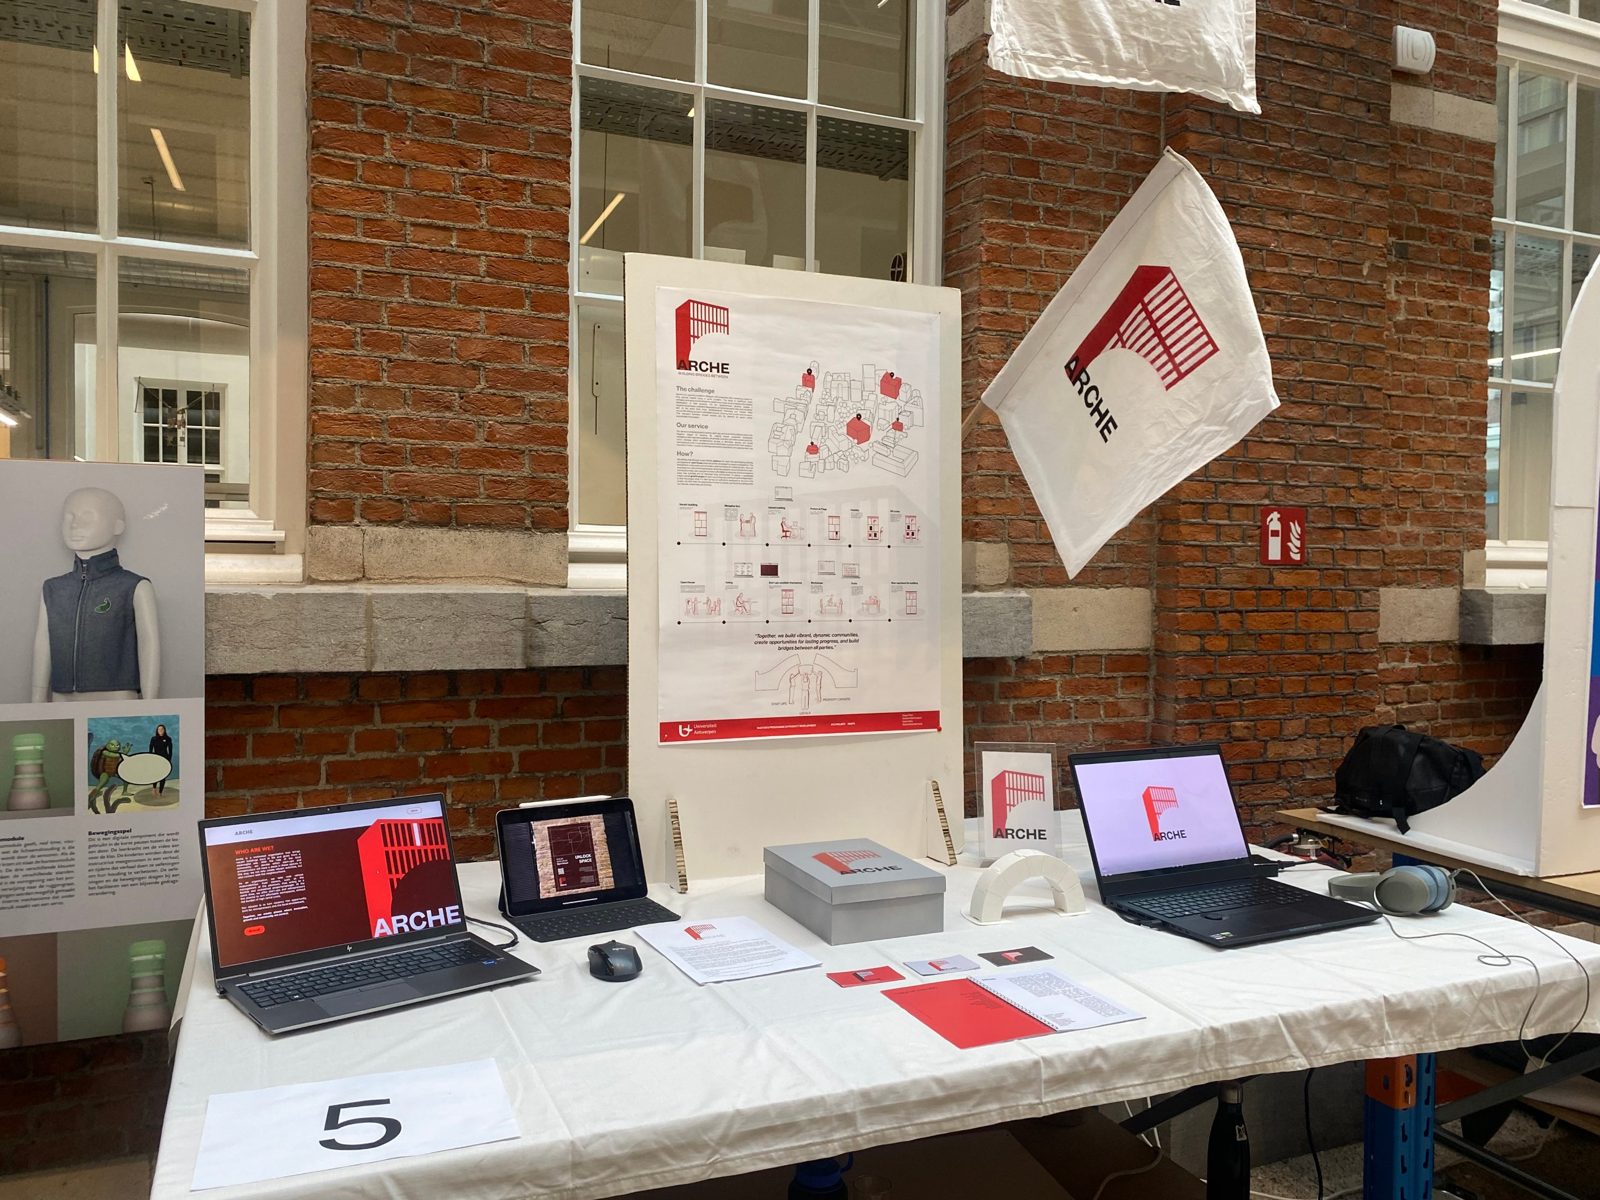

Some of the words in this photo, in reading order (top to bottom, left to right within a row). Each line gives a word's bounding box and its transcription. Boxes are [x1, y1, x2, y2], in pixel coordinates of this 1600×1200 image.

[677, 359, 730, 374] ARCHE
[1064, 355, 1118, 443] ARCHE
[993, 827, 1048, 840] ARCHE
[1153, 829, 1187, 842] ARCHE
[840, 865, 903, 875] ARCHE
[374, 905, 462, 938] ARCHE
[318, 1098, 402, 1151] 5
